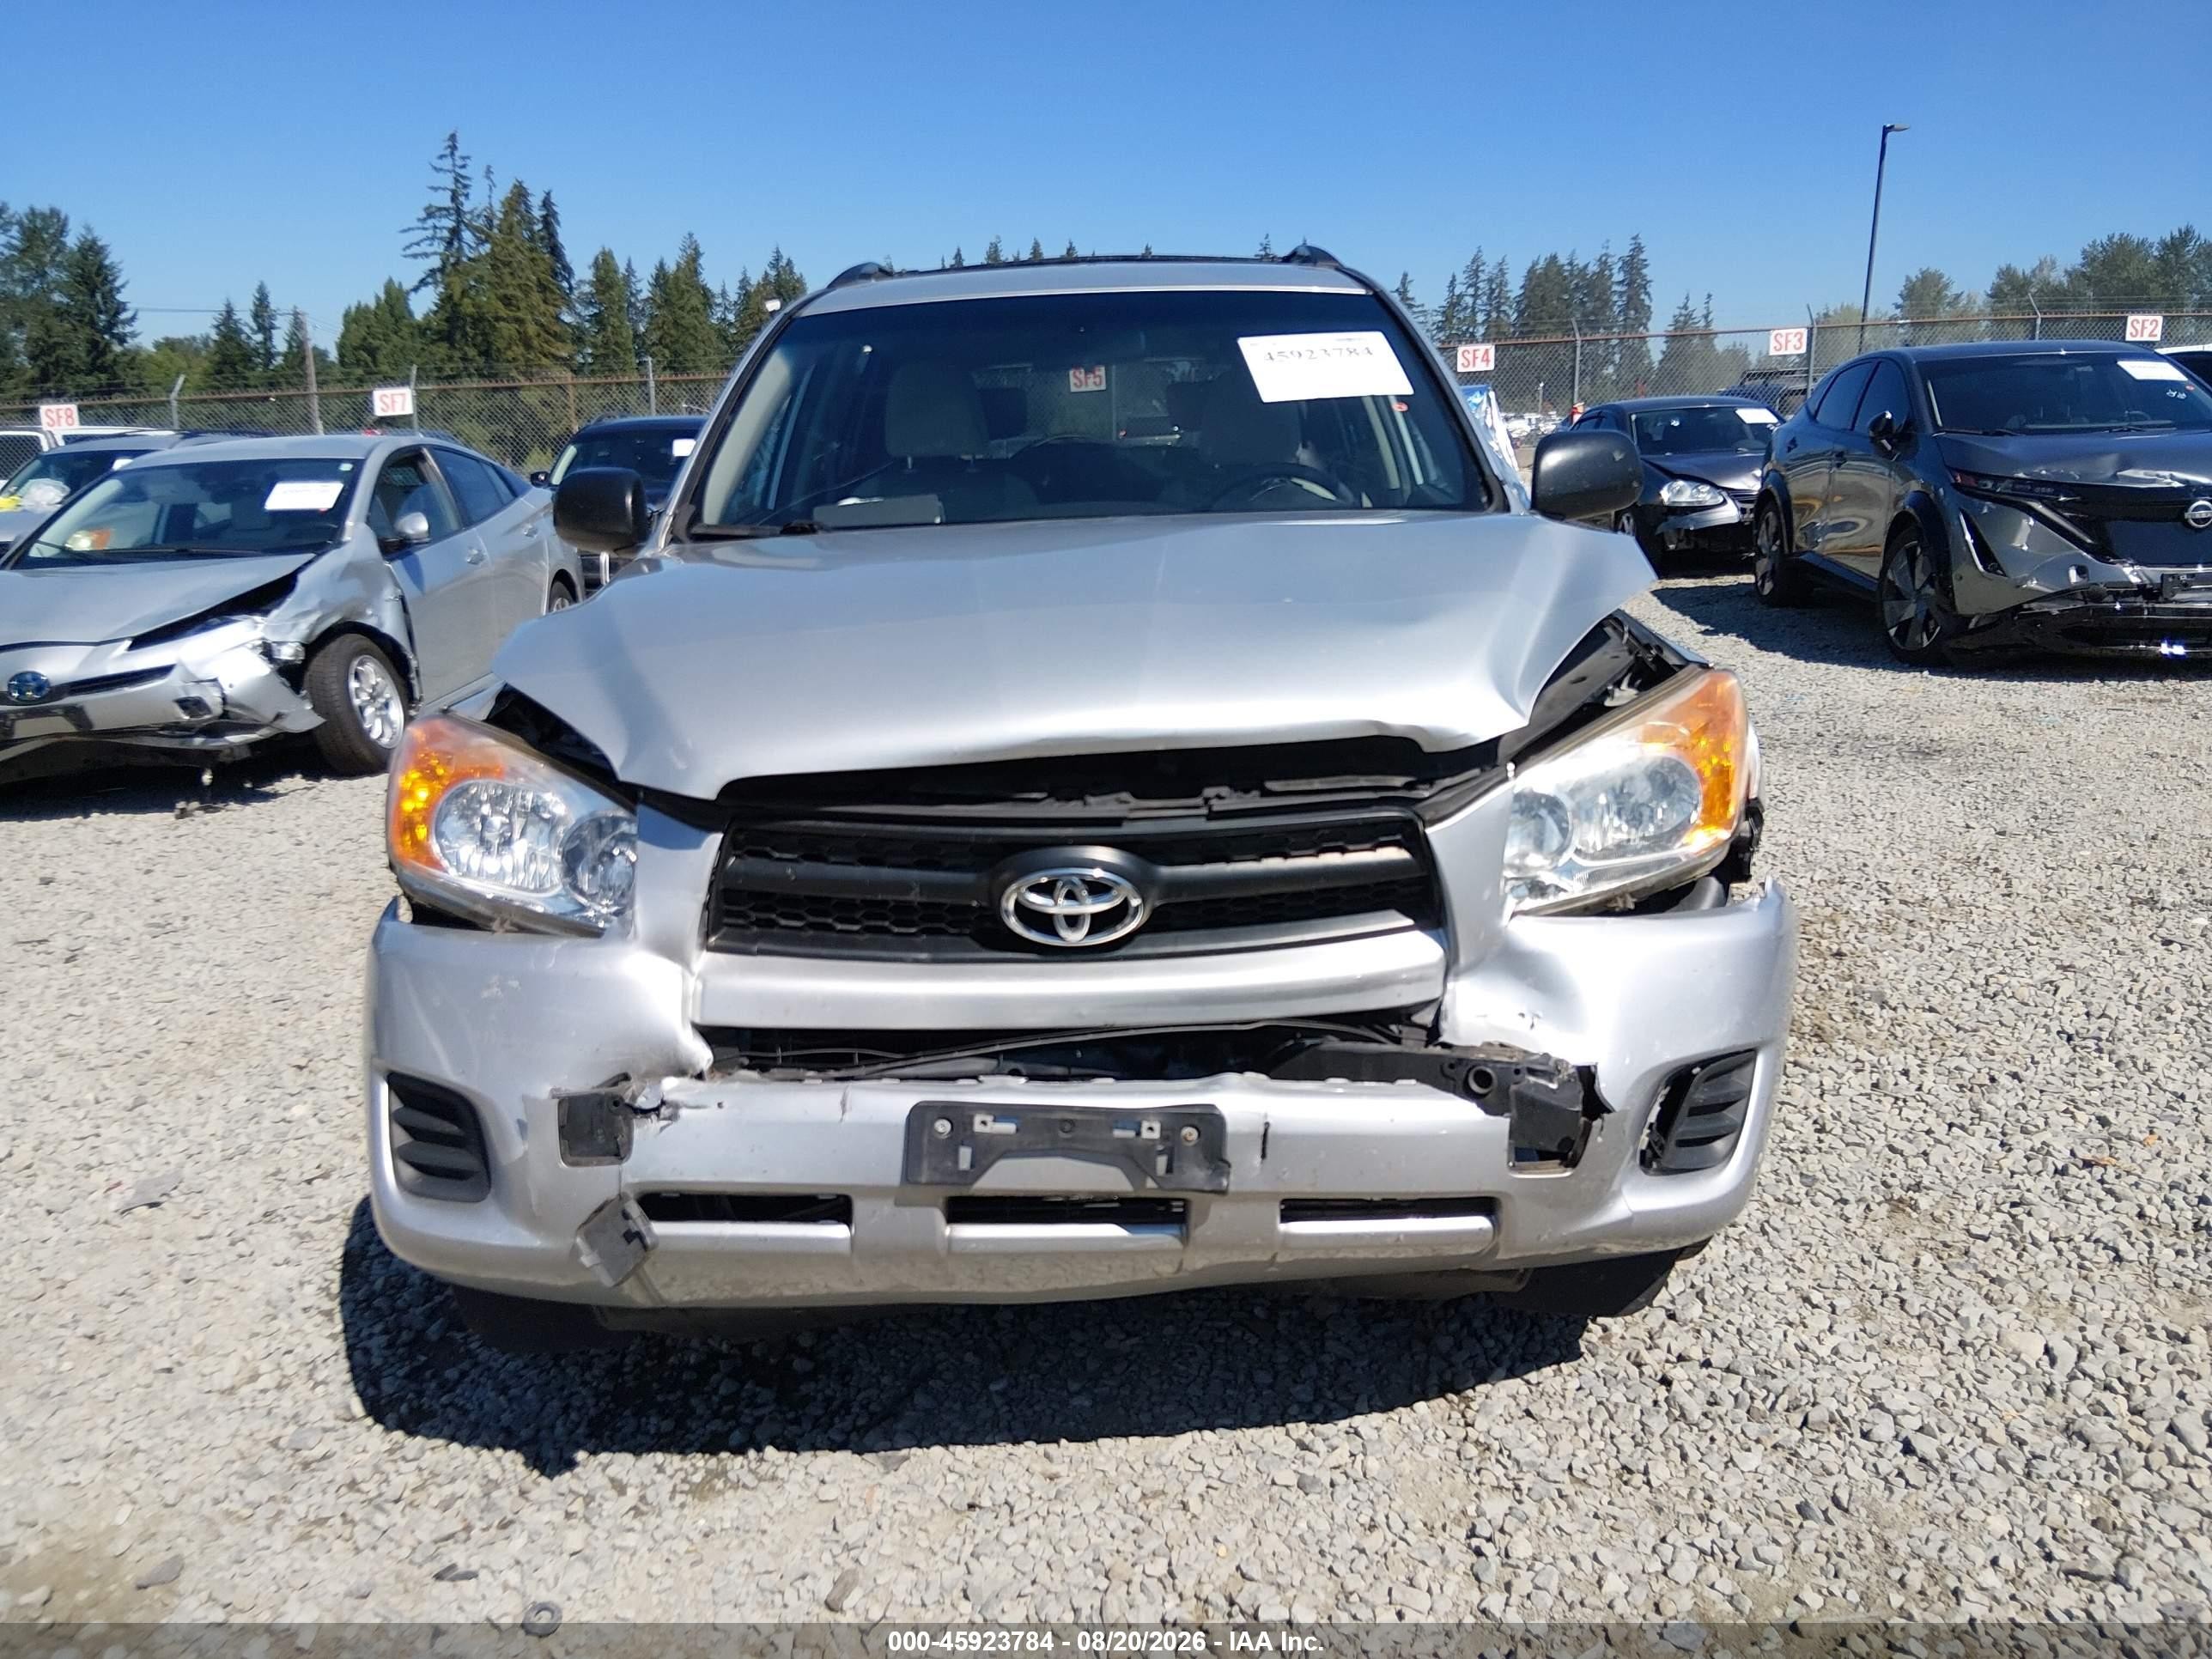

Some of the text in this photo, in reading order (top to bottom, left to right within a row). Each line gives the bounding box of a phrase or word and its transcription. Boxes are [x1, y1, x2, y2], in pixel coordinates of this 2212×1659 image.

[2130, 319, 2159, 338] SF2
[1773, 331, 1803, 352] SF3
[1461, 348, 1491, 368] SF4
[379, 392, 406, 413] SF7
[45, 407, 75, 428] SF8
